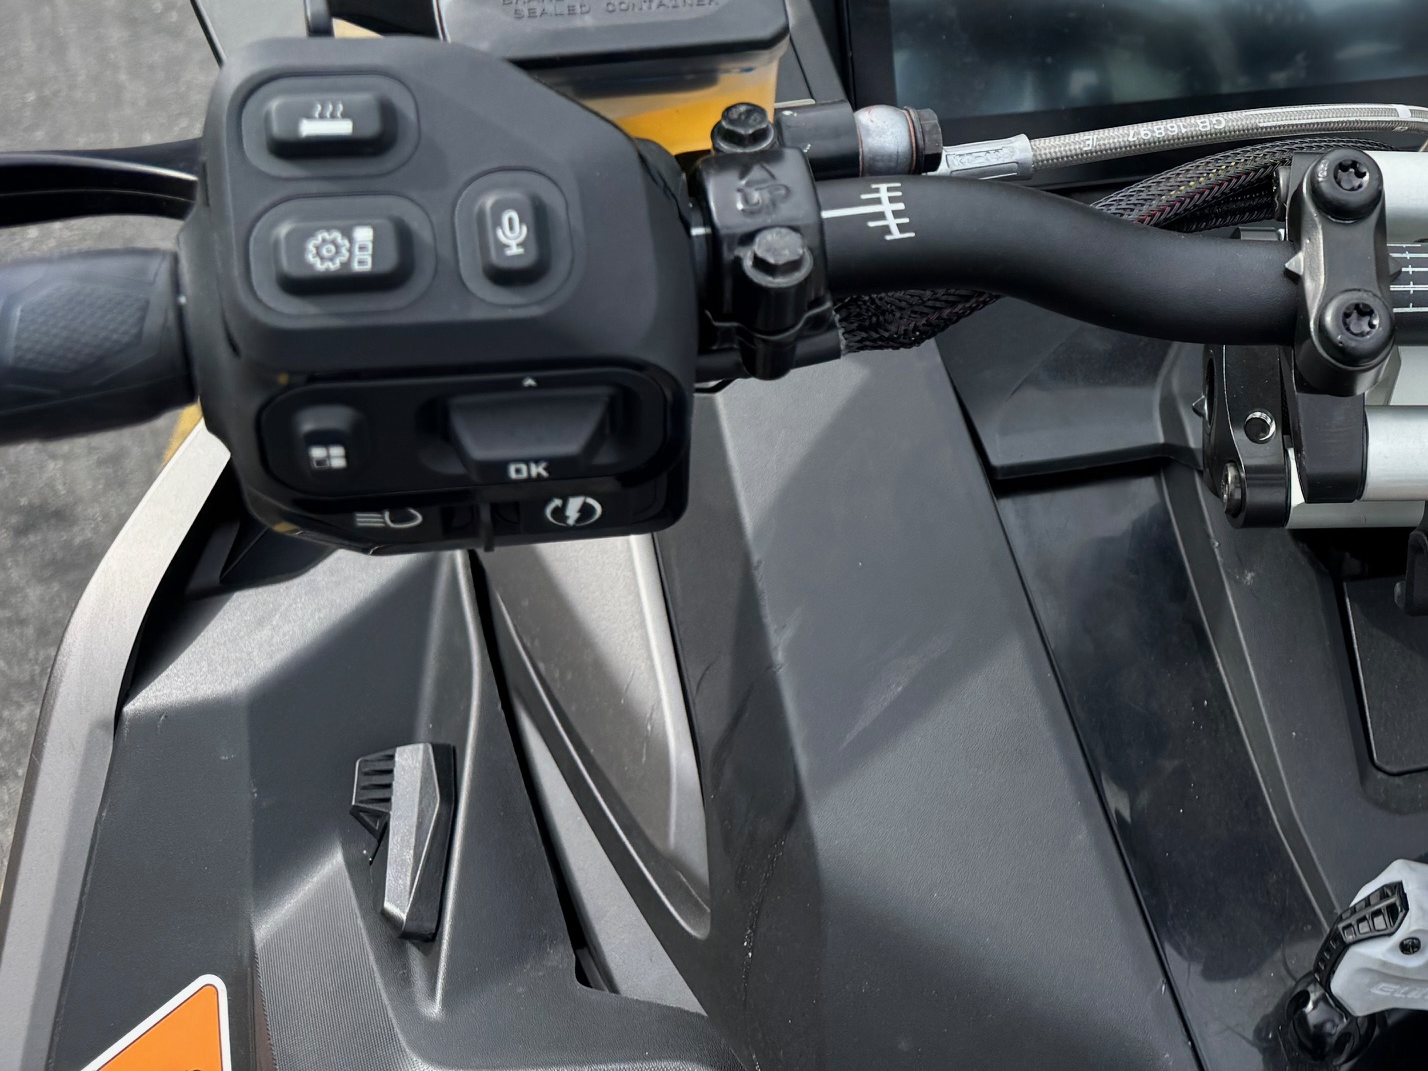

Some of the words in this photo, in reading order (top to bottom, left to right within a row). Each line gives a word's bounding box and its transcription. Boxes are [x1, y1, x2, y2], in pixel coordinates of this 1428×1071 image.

[513, 3, 591, 20] SEALED
[1127, 121, 1188, 143] 16897
[1198, 117, 1226, 131] GB
[508, 460, 550, 479] OK
